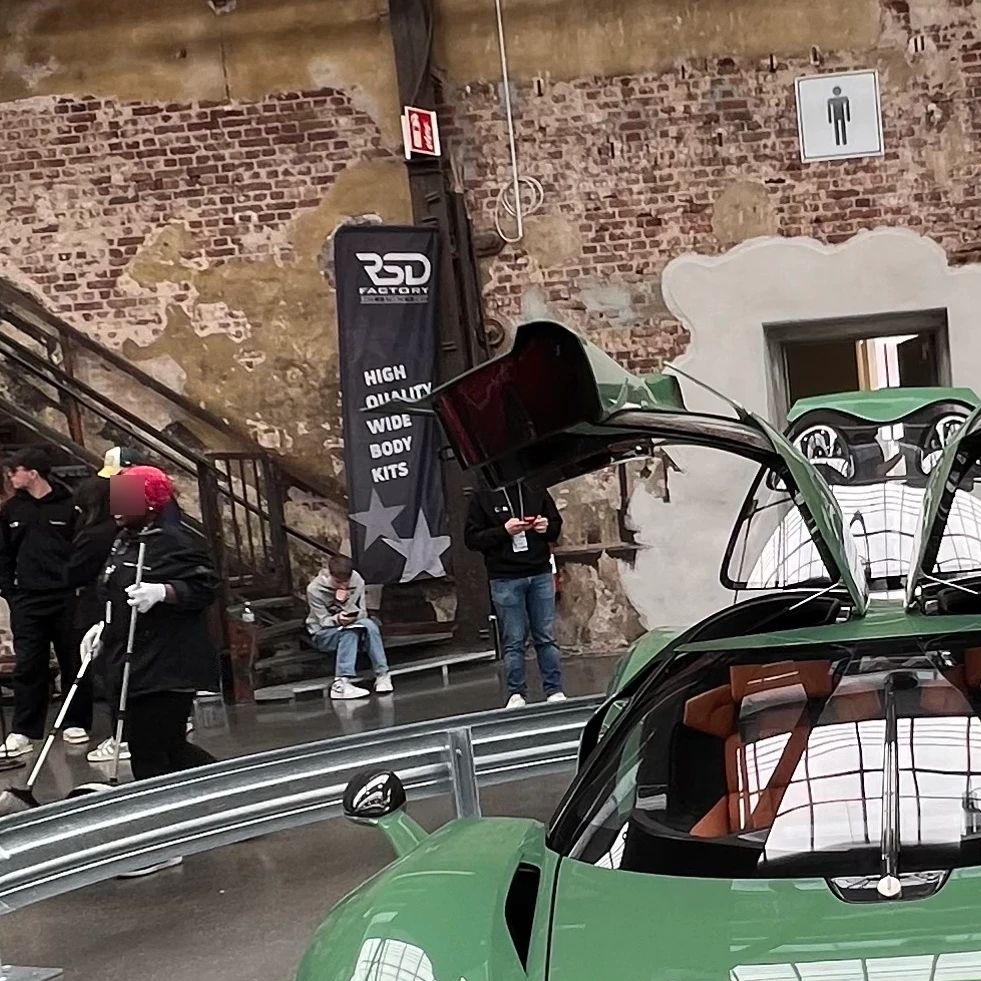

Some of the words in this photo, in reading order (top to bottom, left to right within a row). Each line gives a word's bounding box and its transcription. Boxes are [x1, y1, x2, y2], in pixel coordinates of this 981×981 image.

[355, 252, 432, 286] RSD
[358, 286, 429, 295] FACTORY
[363, 364, 407, 387] HIGH
[366, 413, 413, 435] WIDE
[369, 435, 412, 460] BODY
[371, 461, 409, 483] KITS
